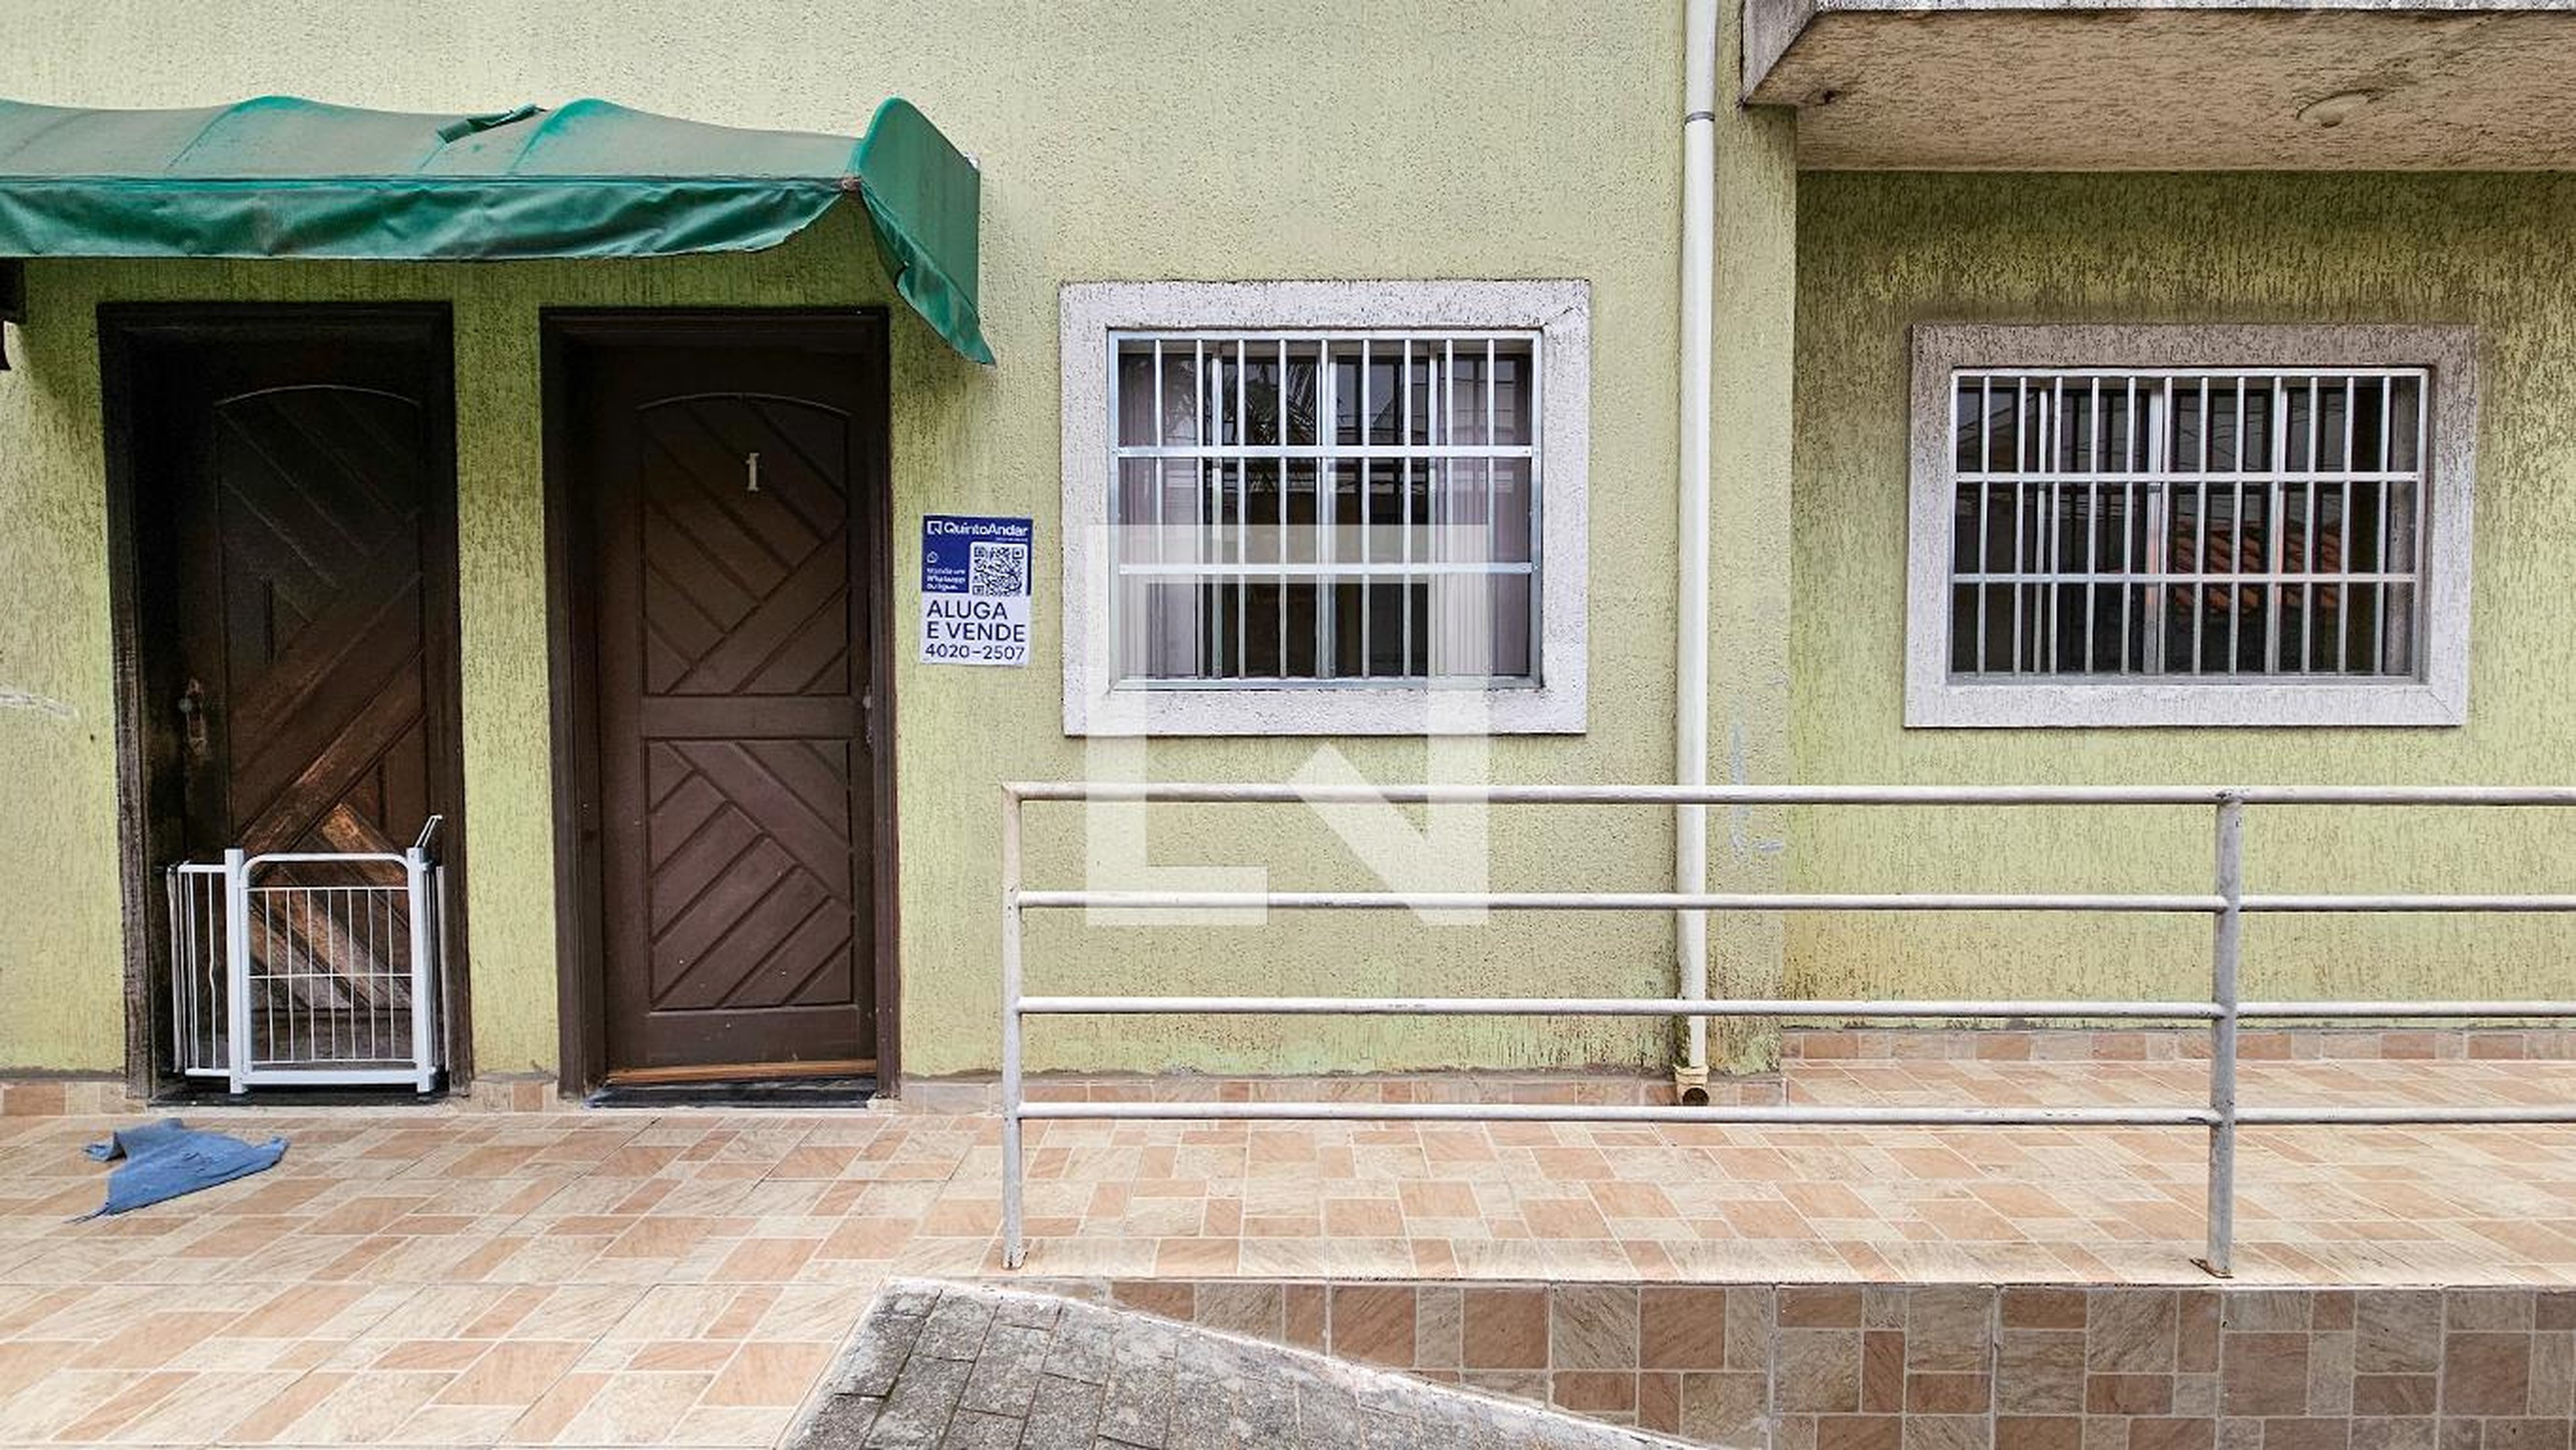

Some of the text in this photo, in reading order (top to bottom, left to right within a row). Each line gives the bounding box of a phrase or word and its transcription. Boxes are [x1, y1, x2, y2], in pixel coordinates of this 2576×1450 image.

[944, 522, 1028, 536] QuintoAndar
[926, 600, 1008, 620] ALUGA
[926, 621, 1026, 643] E VENDE
[925, 643, 1024, 661] 4020-2507
